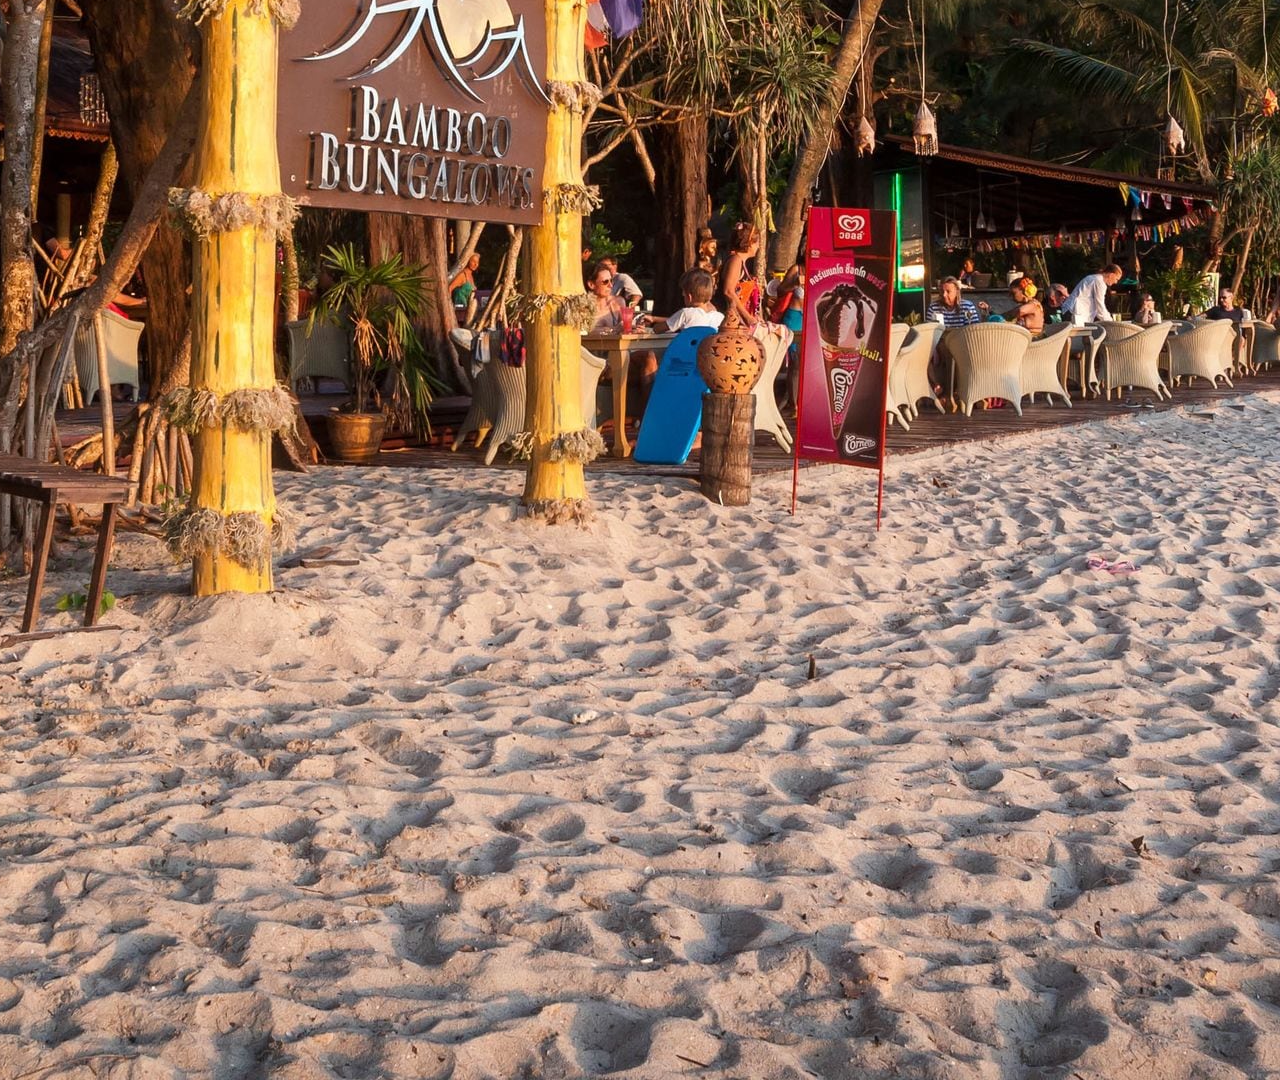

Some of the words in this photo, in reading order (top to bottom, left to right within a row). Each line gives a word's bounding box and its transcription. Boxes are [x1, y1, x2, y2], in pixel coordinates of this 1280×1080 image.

[360, 85, 512, 159] BAMBOO
[318, 132, 535, 210] BUNGALOWS
[830, 368, 855, 413] Cornetto
[845, 434, 876, 453] Cornetto
